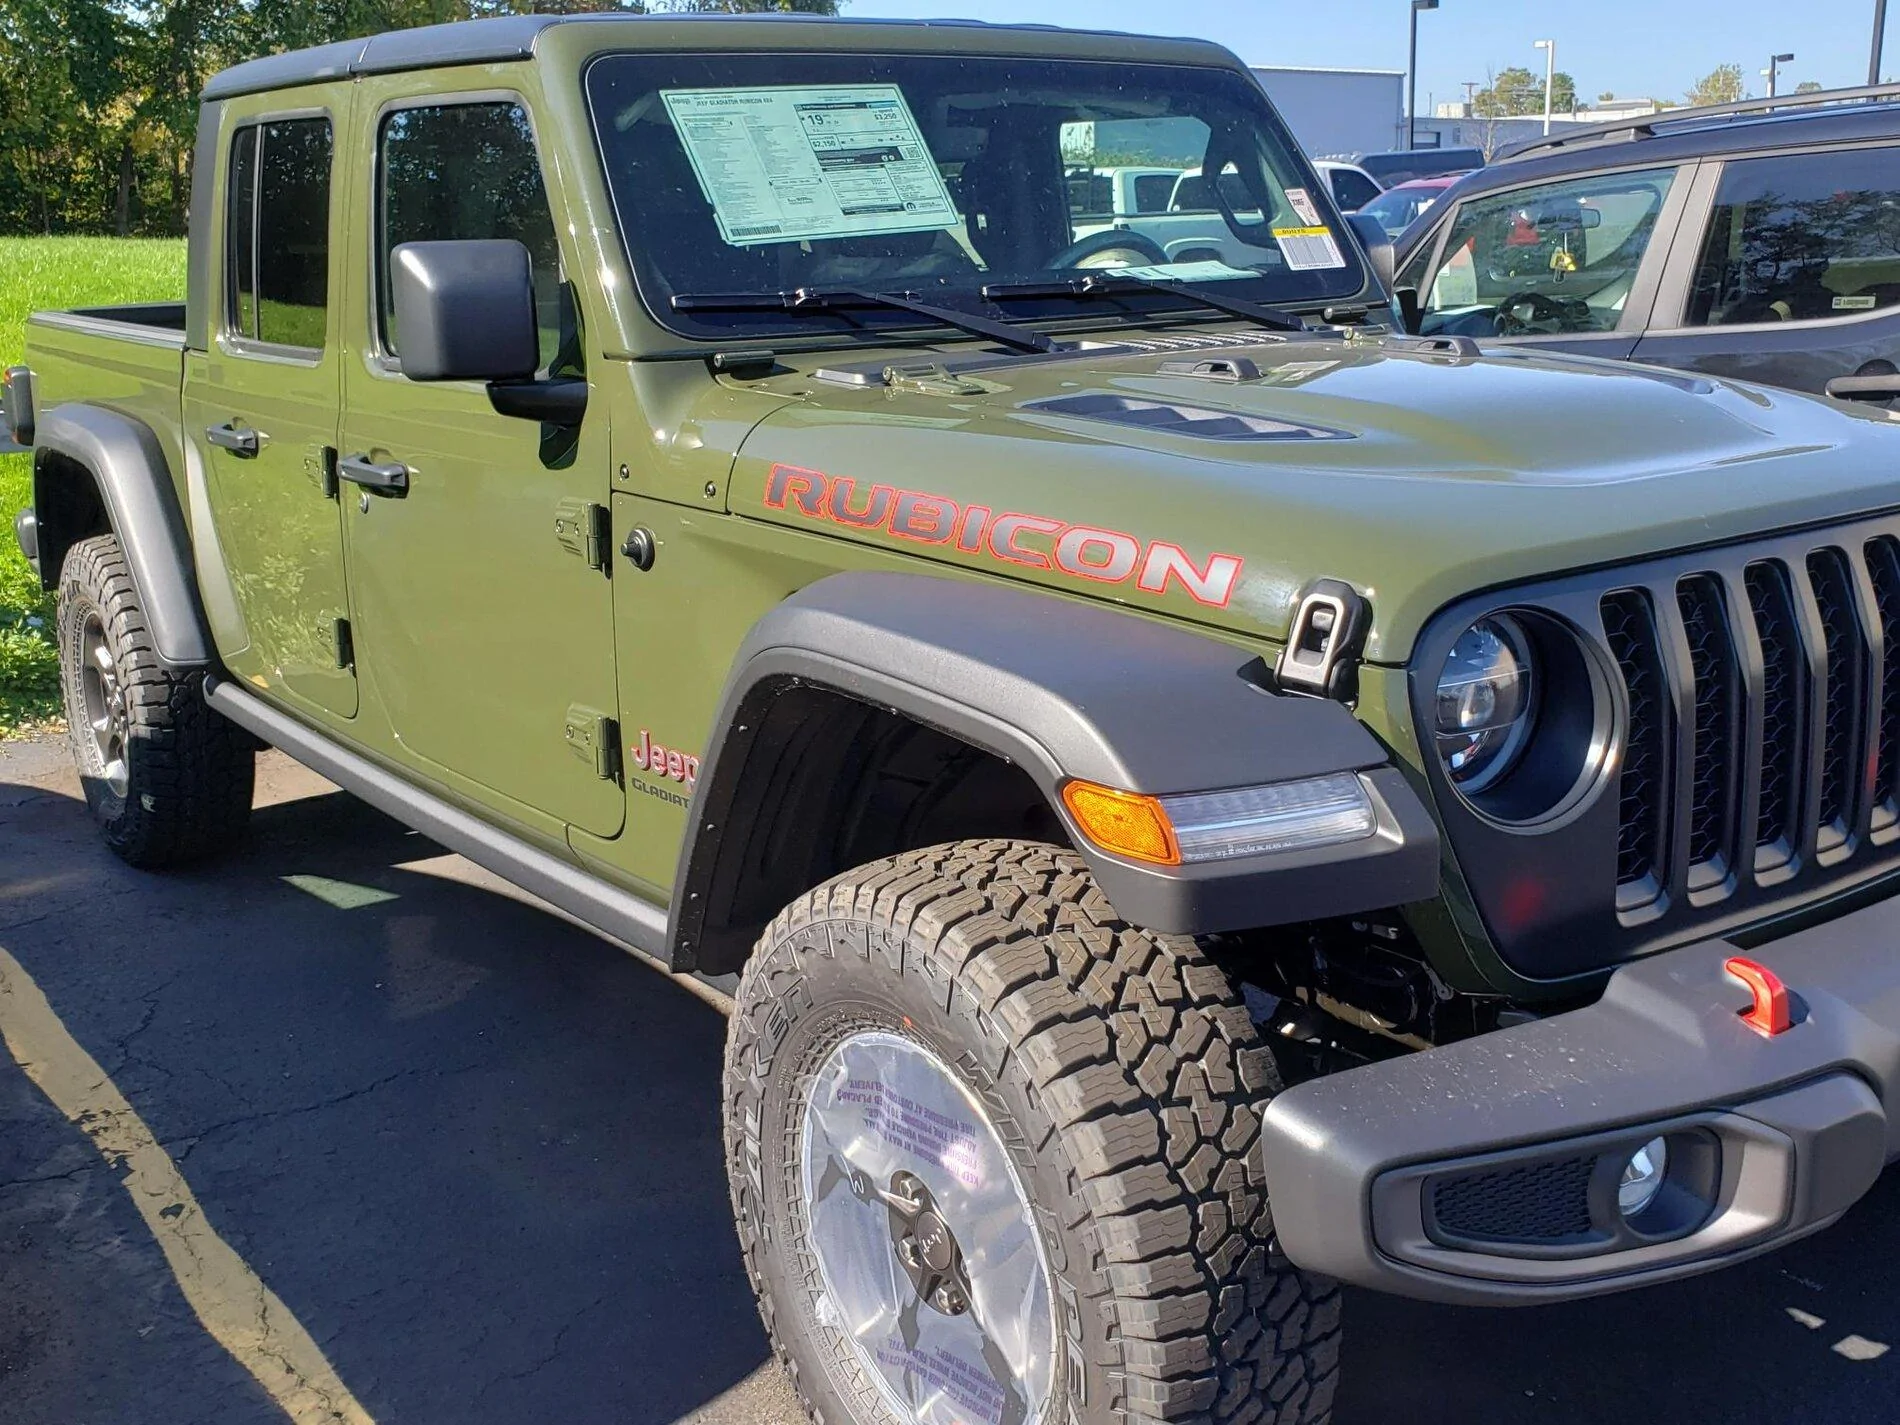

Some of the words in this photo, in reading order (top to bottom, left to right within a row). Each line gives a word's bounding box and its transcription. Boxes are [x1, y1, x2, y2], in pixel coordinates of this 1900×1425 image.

[808, 114, 824, 126] 19
[764, 463, 1244, 609] RUBICON
[631, 728, 700, 793] Jeep
